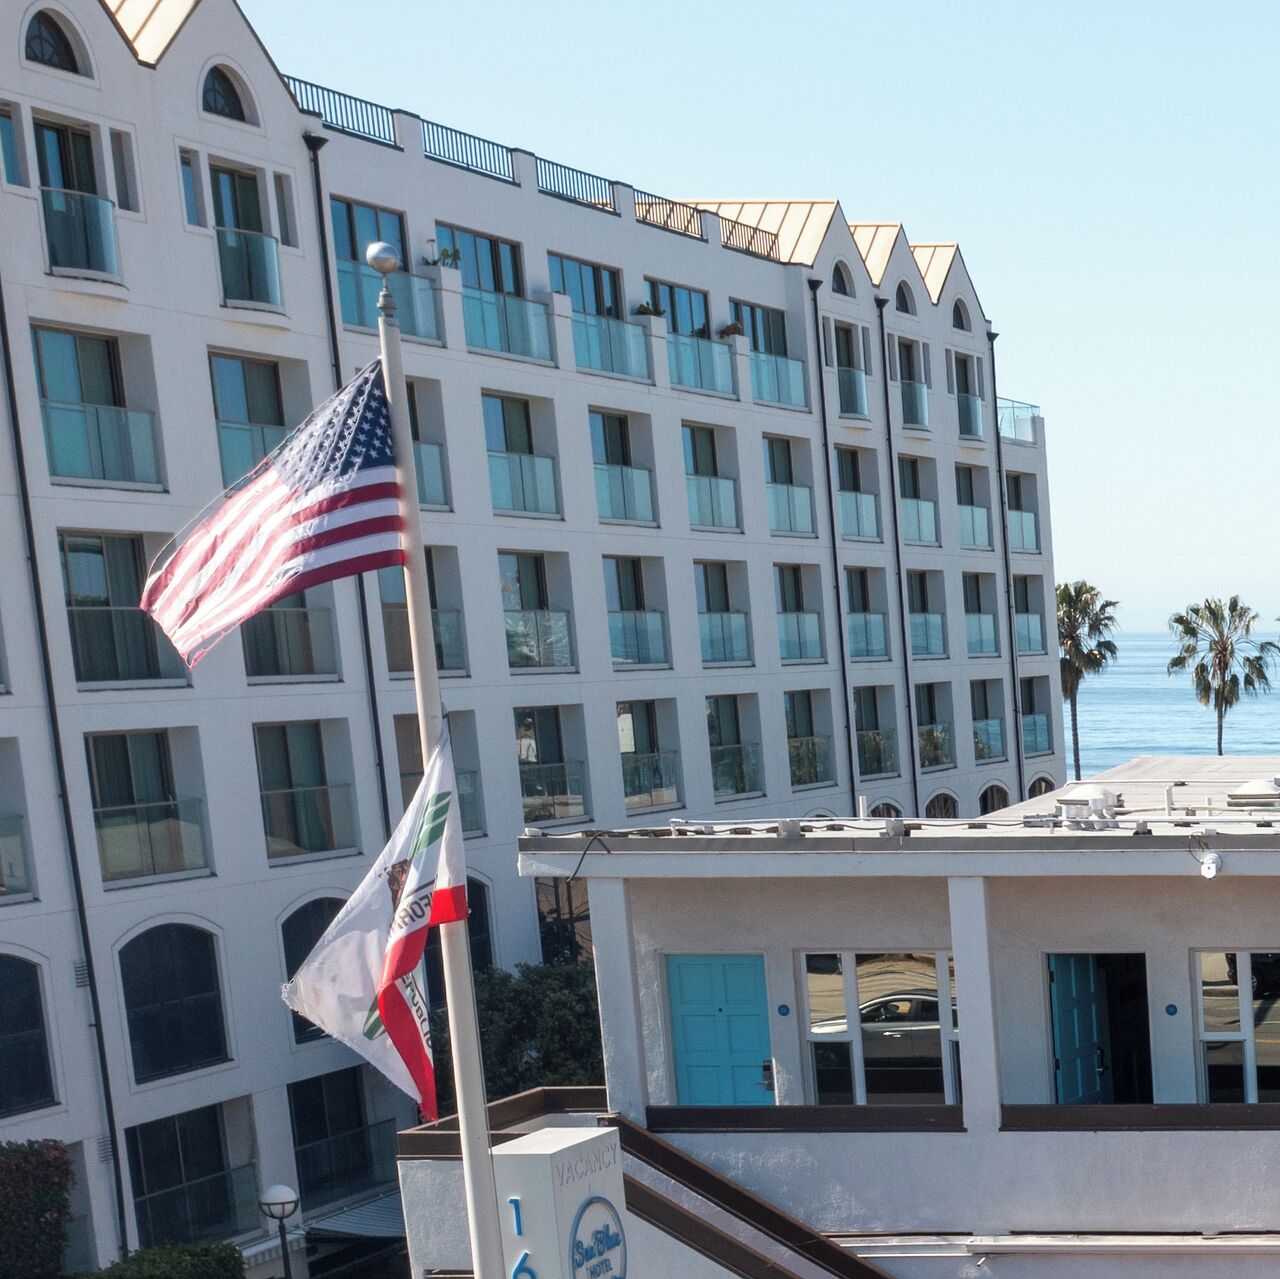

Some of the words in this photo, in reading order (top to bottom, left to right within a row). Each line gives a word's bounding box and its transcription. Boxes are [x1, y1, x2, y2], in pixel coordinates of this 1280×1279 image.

[555, 1142, 619, 1186] VACANCY
[575, 1240, 596, 1268] Sea
[592, 1224, 622, 1257] Blue
[587, 1258, 613, 1279] HOTEL
